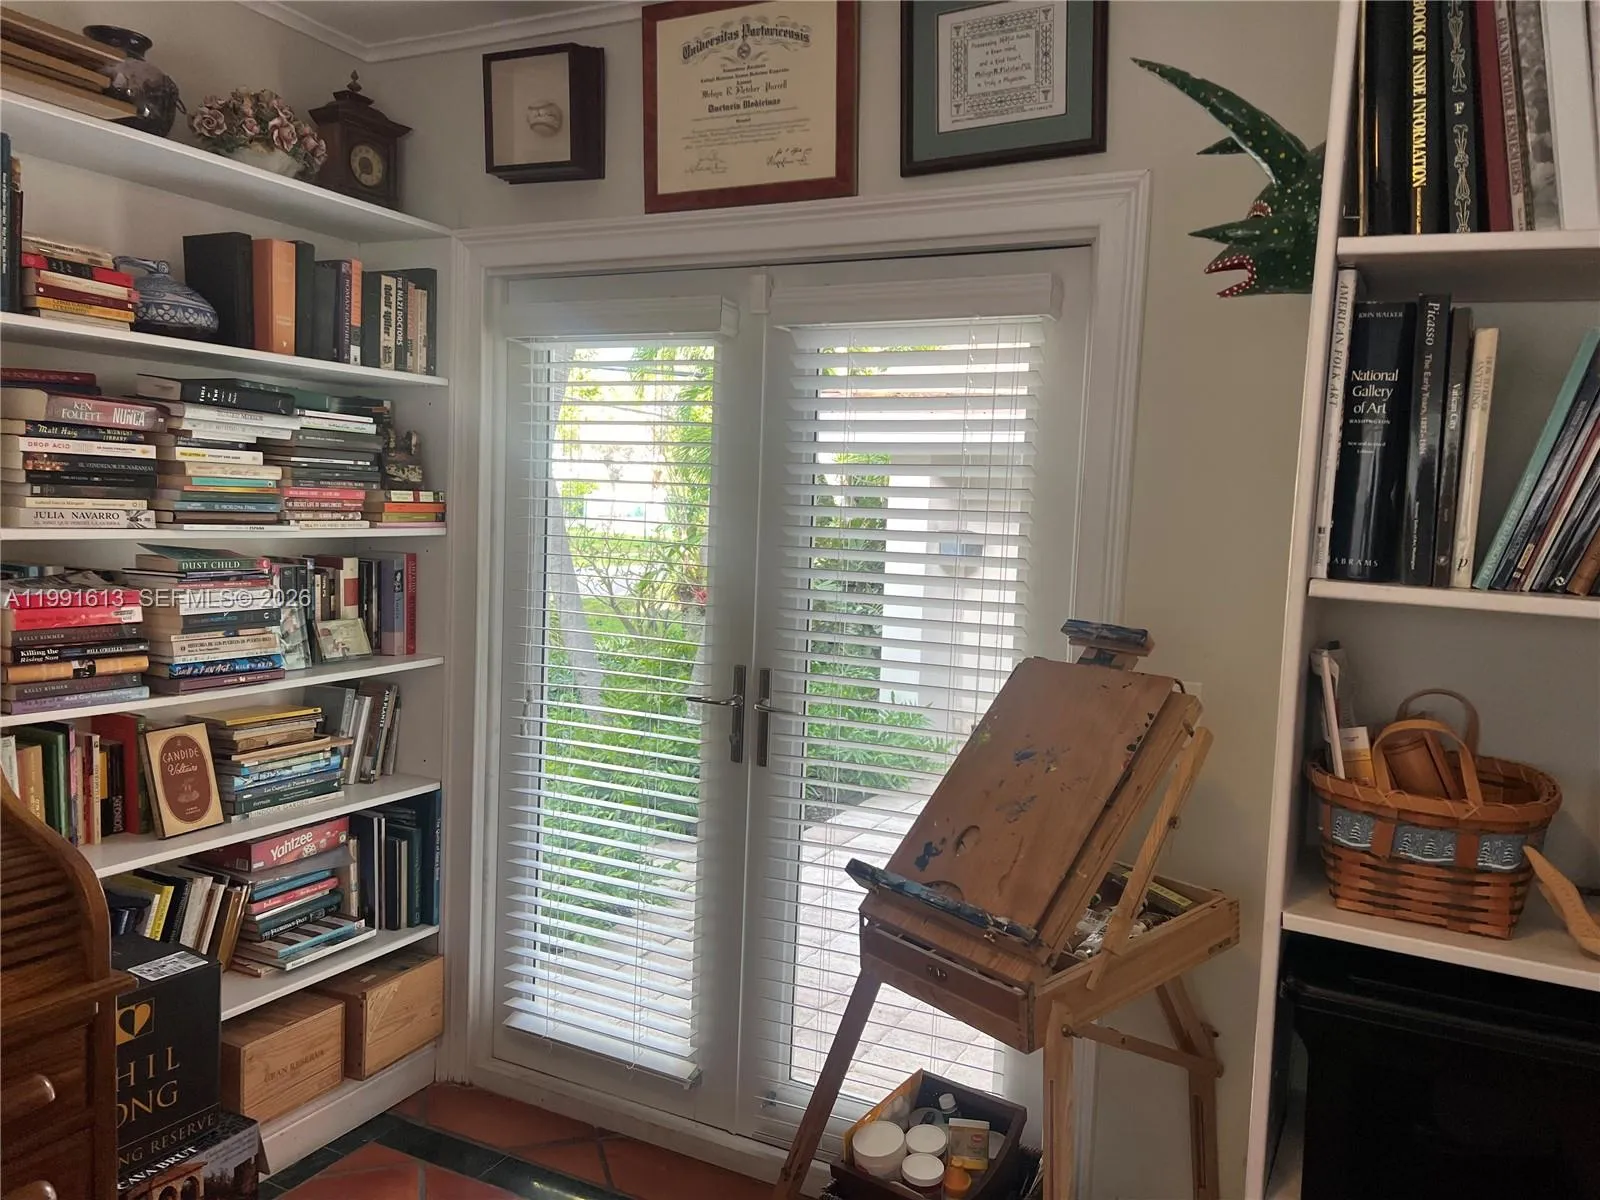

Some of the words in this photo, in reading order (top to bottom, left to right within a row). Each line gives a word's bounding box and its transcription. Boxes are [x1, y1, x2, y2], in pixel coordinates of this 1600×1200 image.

[1413, 36, 1426, 52] OF
[1412, 55, 1426, 97] INSIDE
[1453, 102, 1465, 115] F
[1412, 99, 1426, 188] INFORMATION
[396, 290, 404, 311] NAZI
[1334, 282, 1350, 346] AMERICAN
[396, 311, 404, 346] DOCTORS
[1425, 302, 1441, 346] Picasso
[1331, 348, 1343, 381] FOLK
[1424, 353, 1433, 369] The
[1351, 369, 1399, 383] National
[1328, 385, 1339, 409] ART
[1352, 385, 1394, 400] Gallery
[1451, 383, 1462, 412] Vatican
[61, 408, 104, 422] FOLLETT
[73, 402, 94, 411] KEN
[1353, 403, 1363, 414] of
[1366, 402, 1387, 414] Art
[112, 407, 145, 427] NUNCA
[1448, 413, 1459, 431] City
[37, 423, 59, 435] Matt
[60, 427, 79, 438] Haig
[33, 511, 65, 520] JULIA
[71, 511, 120, 520] NAVARRO
[182, 561, 208, 570] DUST
[210, 560, 240, 569] CHILD
[1333, 557, 1379, 568] ABRAMS
[20, 649, 46, 658] Killing
[24, 686, 42, 694] KELLY
[162, 747, 199, 764] CANDIDE
[167, 763, 198, 776] Voltaire
[269, 831, 313, 861] Yahtzee
[116, 1046, 181, 1093] HIL
[116, 1079, 178, 1129] ONG
[117, 1149, 143, 1168] NG
[151, 1111, 216, 1154] RESERVE
[117, 1164, 159, 1190] CAVA
[155, 1145, 198, 1174] BRUT
